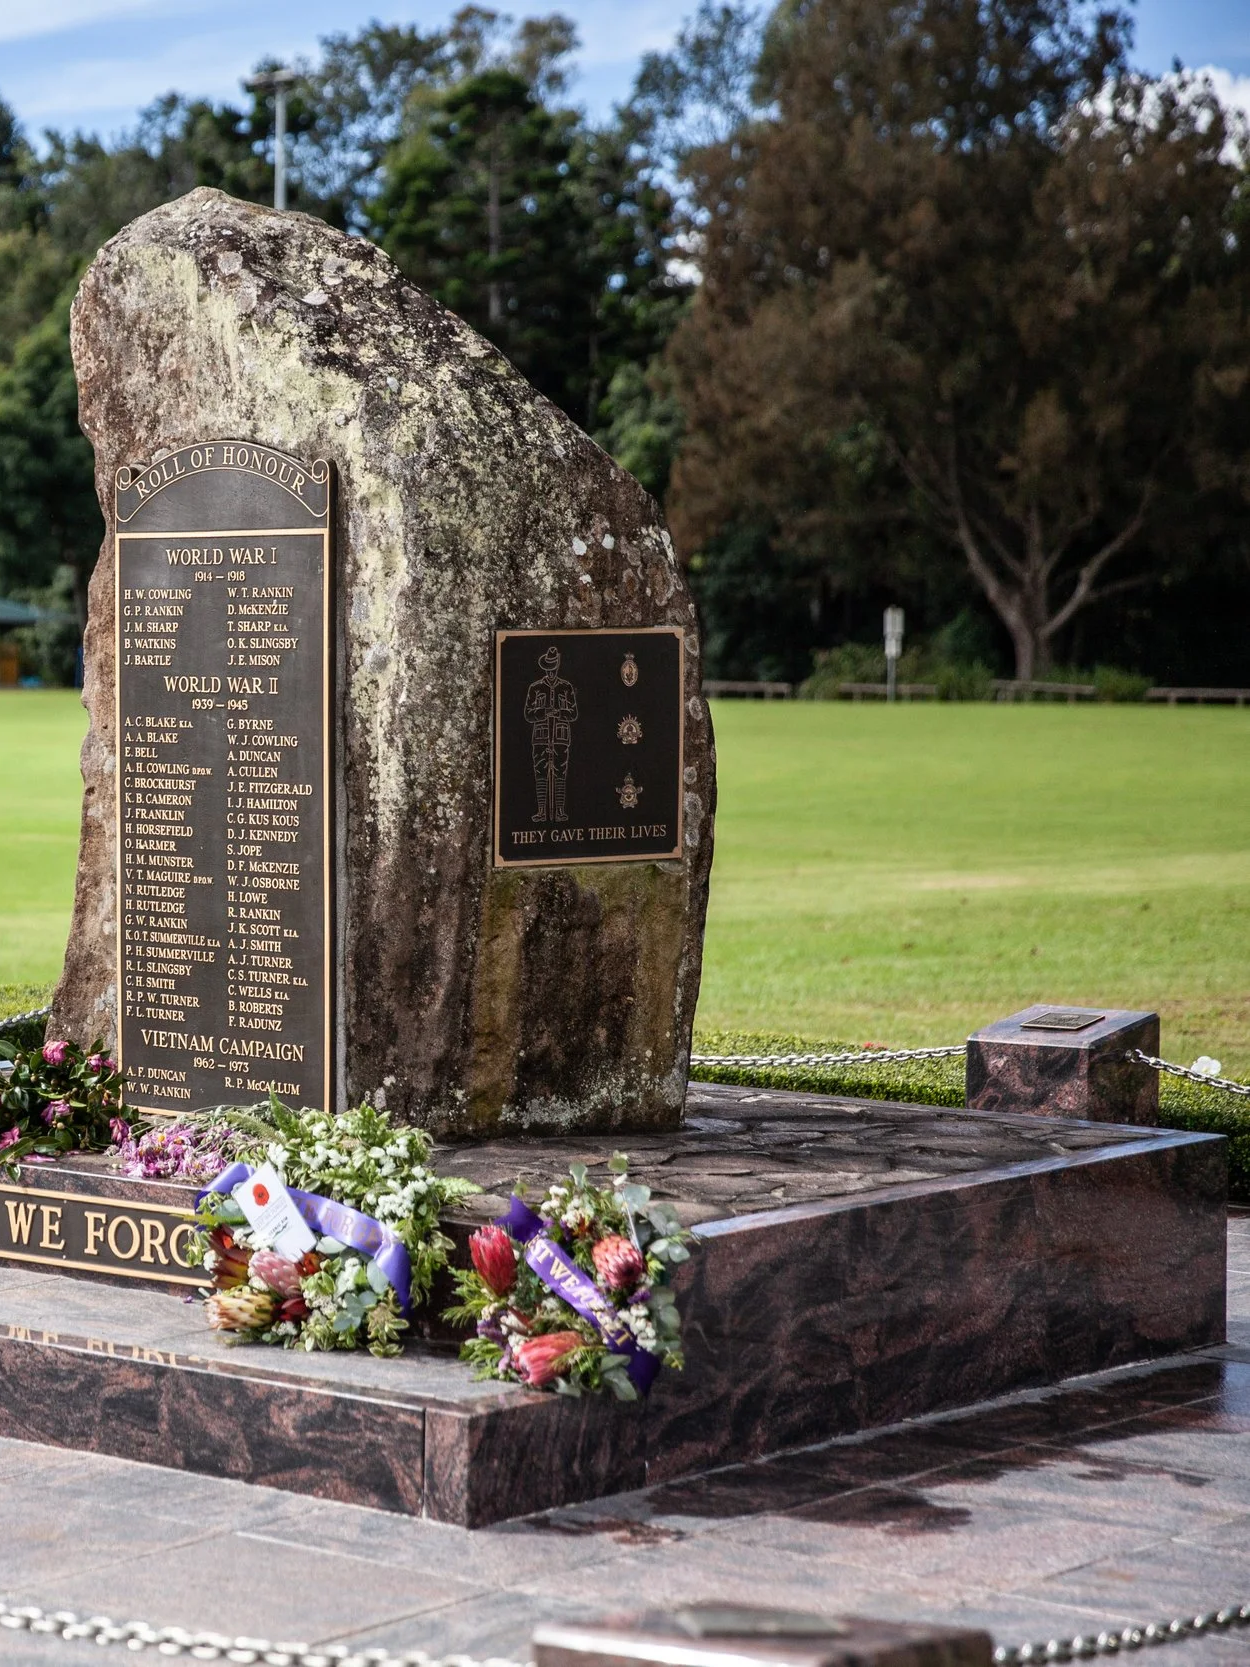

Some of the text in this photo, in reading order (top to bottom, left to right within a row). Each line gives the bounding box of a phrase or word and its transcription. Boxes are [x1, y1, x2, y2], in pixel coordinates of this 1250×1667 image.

[135, 447, 305, 499] ROLL OF HONOUR
[166, 548, 276, 565] WORLD WAR I
[195, 571, 245, 582] 1914 1918
[124, 589, 191, 599] H. W. COWLING
[228, 587, 293, 598] W. T. RANKIN
[124, 606, 183, 616] G. P. RANKIN
[228, 604, 288, 615] D. McKENZIE
[124, 622, 178, 633] J. M. SHARP
[227, 622, 270, 632] T. SHARP
[124, 639, 176, 649] B. WATKINS
[228, 638, 298, 649] O. K. SLINGSBY
[124, 656, 171, 666] J. BARTLE
[228, 655, 280, 665] J. E. MISON
[164, 676, 278, 694] WORLD WAR II
[192, 699, 248, 710] 1939 1945
[125, 717, 176, 728] A. C. BLAKE
[227, 720, 273, 730] G. BYRNE
[227, 735, 298, 747] W. J. COWLING
[227, 751, 281, 762] A. DUNCAN
[125, 763, 190, 774] A. H. COWLING
[227, 767, 278, 778] A. CULLEN
[125, 778, 196, 790] C. BROCKHURST
[227, 782, 312, 795] J. E. FITZGERALD
[125, 793, 192, 805] K. B. CAMERON
[125, 809, 185, 820] J. FRANKLIN
[227, 814, 299, 826] C. G. KUS KOUS
[125, 824, 193, 836] H. HORSEFIELD
[228, 829, 298, 842] D. J. KENNEDY
[512, 825, 666, 844] THEY GAVE THEIR LIVES
[125, 839, 176, 851] O. HARMER
[227, 845, 262, 856] S. JOPE
[126, 854, 193, 868] H. M. MUNSTER
[228, 860, 299, 874] D. F. McKENZIE
[126, 870, 190, 883] V. T. MAGUIRE
[228, 876, 299, 890] W. J. OSBORNE
[125, 885, 185, 898] N. RUTLEDGE
[228, 892, 267, 904] H. LOWE
[228, 908, 281, 920] R. RANKIN
[125, 915, 188, 929] G. W. RANKIN
[228, 923, 280, 936] J. K. SCOTT
[228, 939, 281, 952] A. J. SMITH
[126, 945, 214, 962] P. H. SUMMERVILLE
[126, 960, 192, 976] R. L. SLINGSBY
[228, 955, 293, 969] A. J. TURNER
[126, 976, 175, 989] C. H. SMITH
[228, 970, 290, 984] C. S. TURNER
[228, 986, 271, 998] C. WELLS
[126, 1006, 185, 1021] F. L. TURNER
[228, 1001, 283, 1015] B. ROBERTS
[229, 1017, 282, 1031] F. RADUNZ
[141, 1029, 304, 1061] VIETNAM CAMPAIGN
[193, 1057, 249, 1072] 1962 1973
[127, 1067, 186, 1082] A. F. DUNCAN
[225, 1078, 234, 1088] R.
[236, 1078, 245, 1089] P.
[5, 1200, 66, 1250] WE
